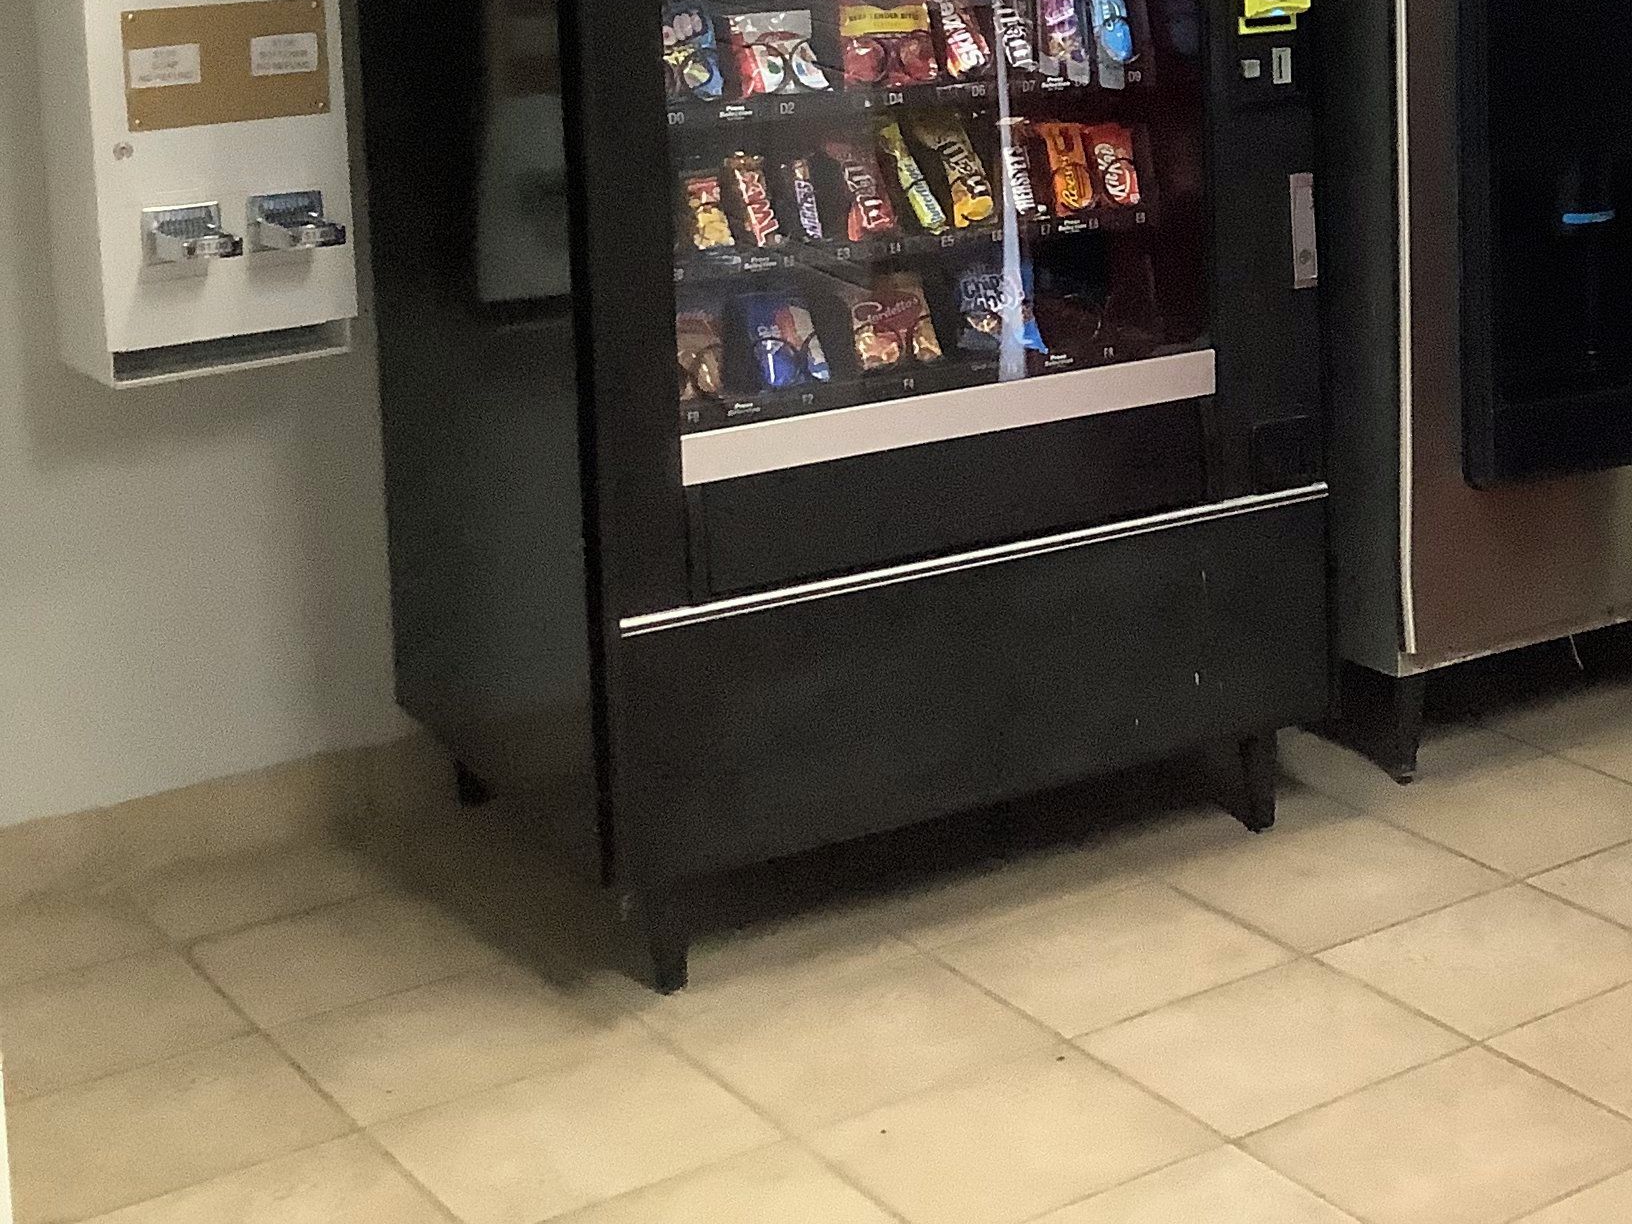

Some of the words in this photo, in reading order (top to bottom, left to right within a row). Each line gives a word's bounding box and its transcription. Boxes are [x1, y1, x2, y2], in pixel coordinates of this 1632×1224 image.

[1128, 71, 1142, 82] D9
[972, 84, 986, 97] D6
[1023, 80, 1036, 92] D7
[780, 102, 795, 114] D2
[667, 112, 684, 125] D0
